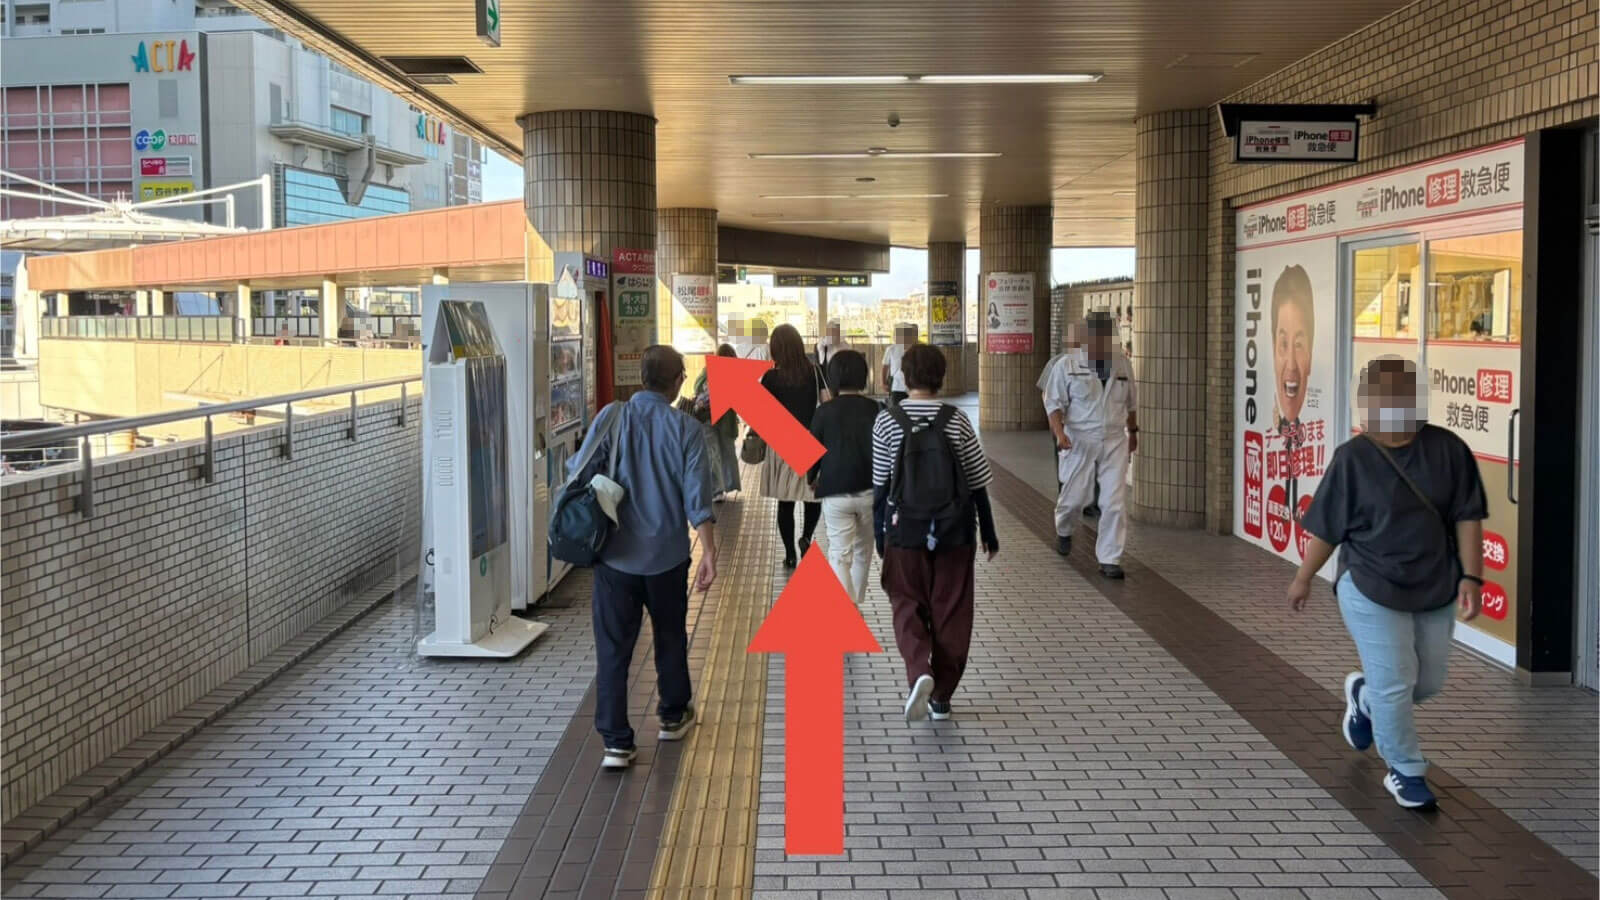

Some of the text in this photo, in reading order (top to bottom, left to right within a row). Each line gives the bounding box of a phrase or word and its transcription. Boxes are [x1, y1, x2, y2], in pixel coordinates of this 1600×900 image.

[131, 40, 196, 73] ACTA
[416, 115, 447, 145] ACTA
[1294, 130, 1328, 140] iPhone
[1380, 185, 1425, 213] iPhone
[1429, 173, 1458, 203] 修理
[1461, 162, 1511, 199] 救急便
[1259, 214, 1286, 235] iPhone
[1289, 205, 1306, 230] 修理
[1308, 200, 1336, 227] 救急便
[1245, 268, 1262, 527] iPhone 修理
[1430, 368, 1510, 401] Phone 修理
[1446, 402, 1489, 433] 救急便
[1482, 538, 1505, 564] 交換
